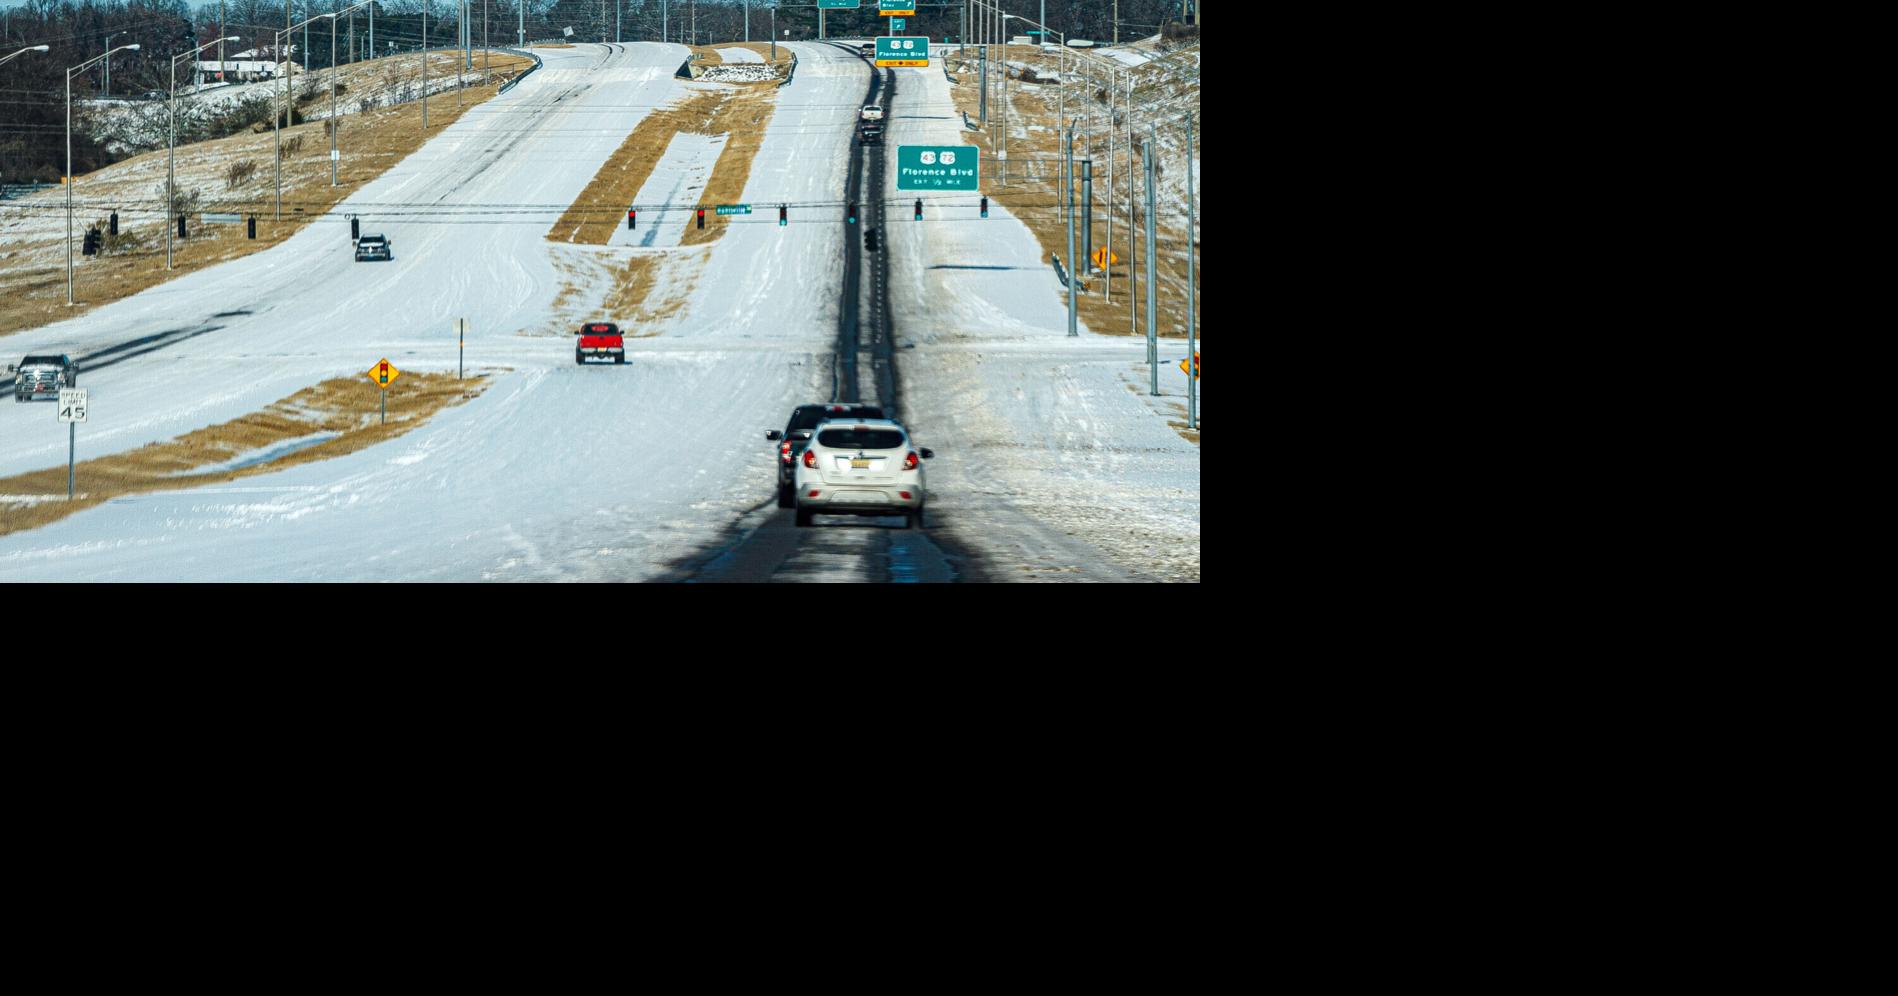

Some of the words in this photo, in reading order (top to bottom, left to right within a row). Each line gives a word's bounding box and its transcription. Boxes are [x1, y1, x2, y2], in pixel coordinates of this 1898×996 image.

[902, 168, 946, 176] Florence
[950, 168, 974, 176] Blvd
[60, 406, 86, 419] 45
